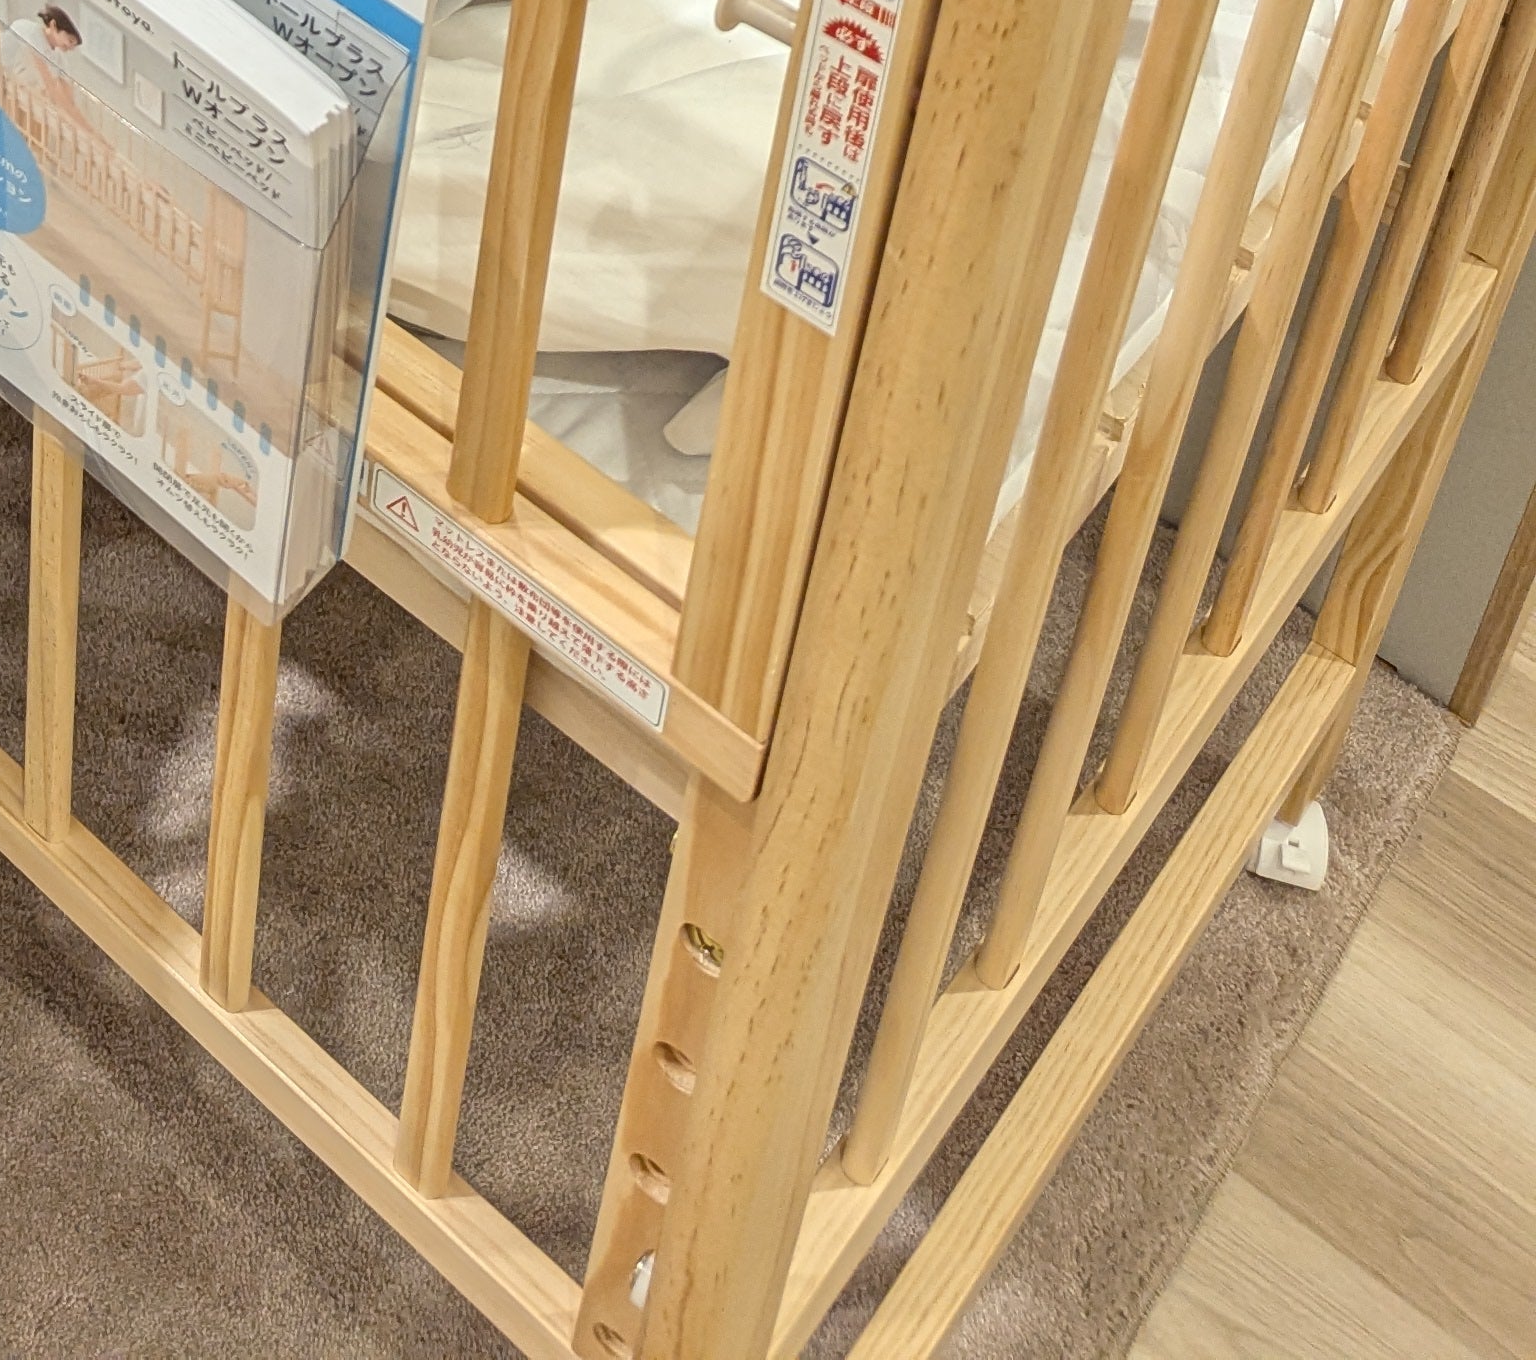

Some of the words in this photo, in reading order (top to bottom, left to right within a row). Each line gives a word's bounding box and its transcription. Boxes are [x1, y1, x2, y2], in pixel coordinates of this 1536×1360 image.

[272, 15, 378, 97] Wオープン
[835, 25, 869, 51] 必ず
[172, 51, 291, 155] トールプラス
[181, 78, 286, 165] Wオープン
